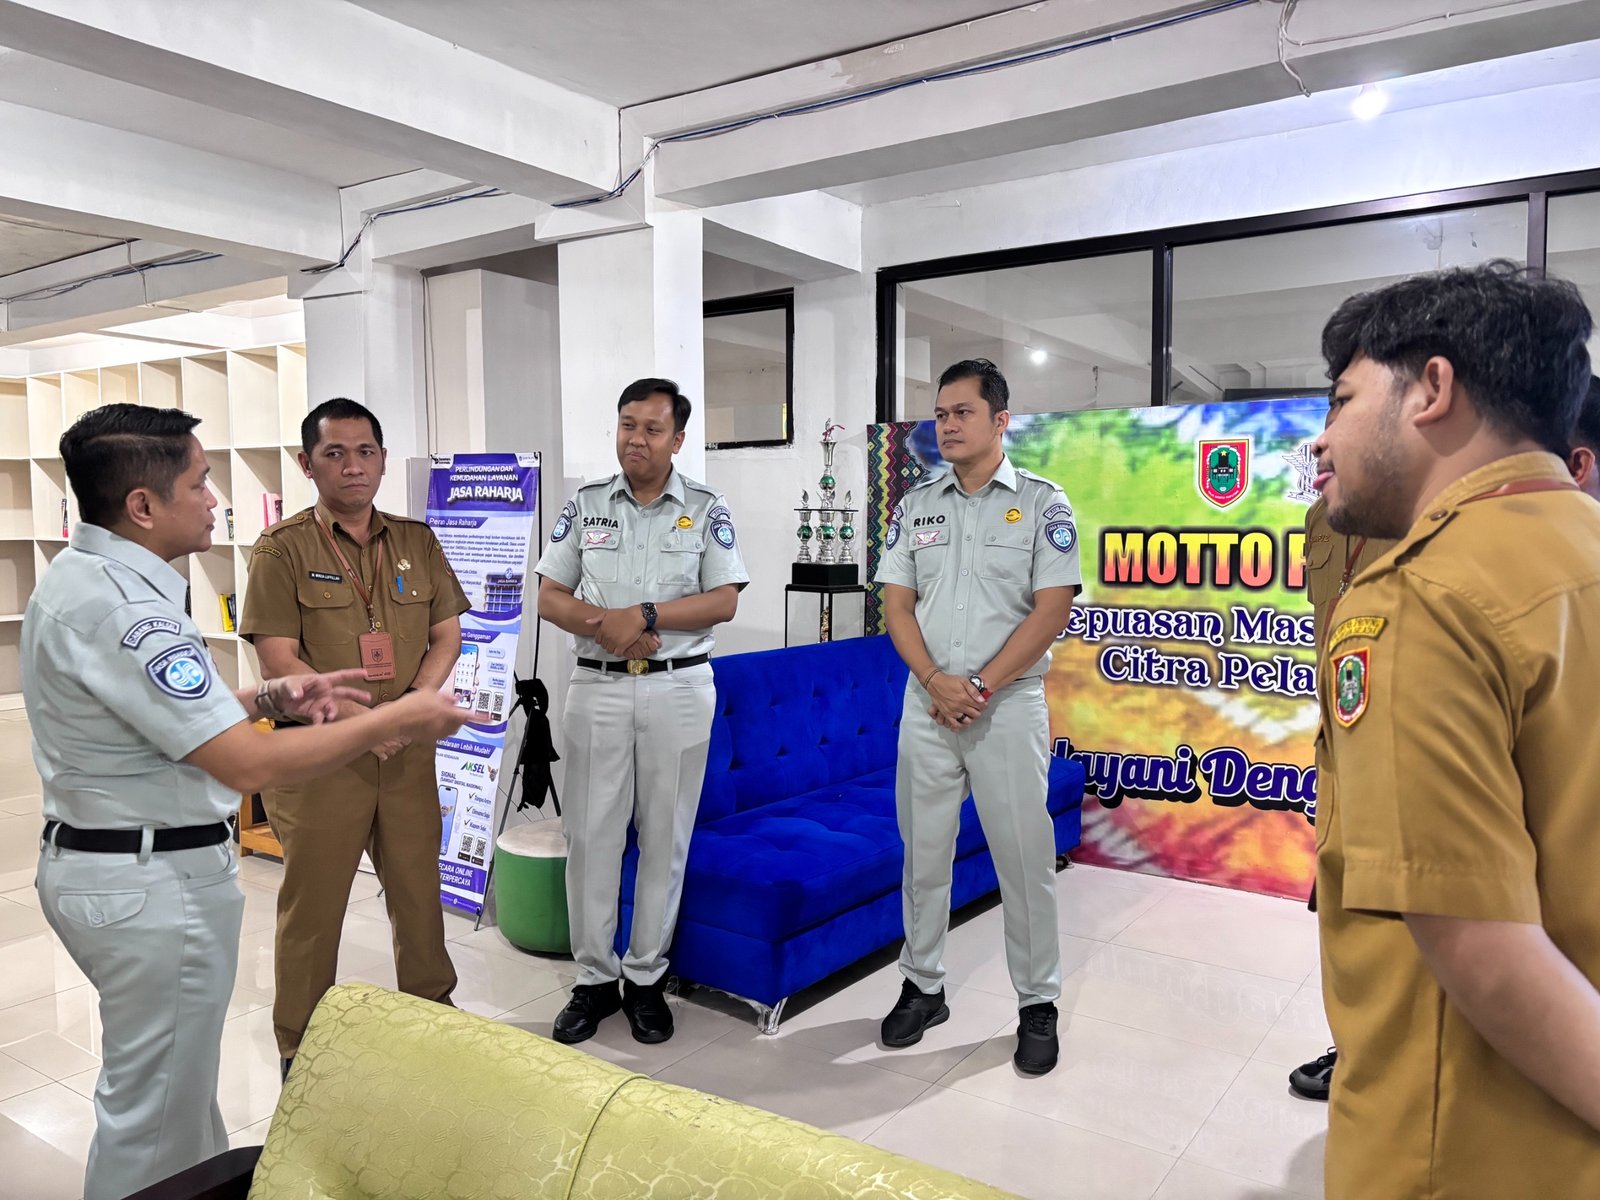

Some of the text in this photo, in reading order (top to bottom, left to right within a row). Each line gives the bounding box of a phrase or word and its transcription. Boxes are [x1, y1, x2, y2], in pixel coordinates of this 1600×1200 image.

[450, 474, 486, 482] KEMUDAHAN
[447, 485, 523, 502] JASA RAHARJA
[446, 518, 458, 526] Jasa
[458, 519, 477, 528] Raharja
[583, 517, 618, 529] SATRIA
[914, 515, 945, 527] RIKO
[1103, 530, 1273, 588] MOTTO
[1056, 606, 1225, 645] epuasan
[466, 632, 492, 640] Genggaman
[1100, 646, 1319, 698] Citra Pela
[460, 742, 473, 751] Lebih
[461, 761, 485, 774] AKSEL
[440, 770, 456, 780] SIGNAL
[454, 866, 474, 878] ONLINE
